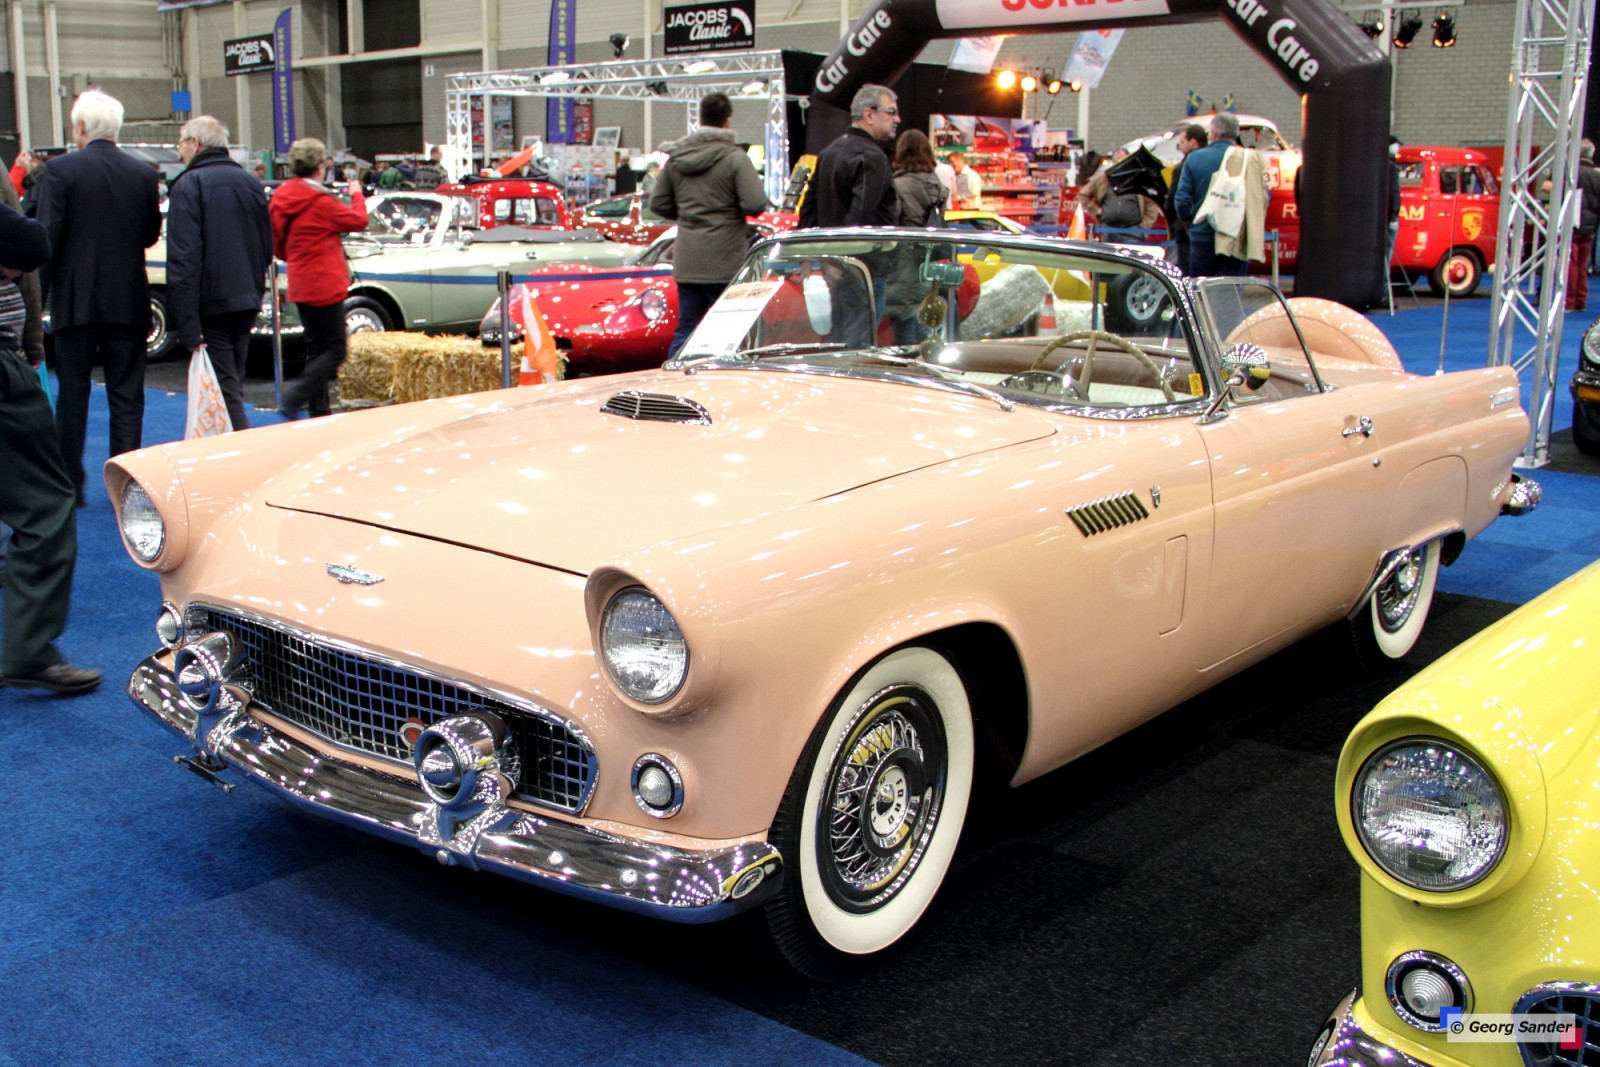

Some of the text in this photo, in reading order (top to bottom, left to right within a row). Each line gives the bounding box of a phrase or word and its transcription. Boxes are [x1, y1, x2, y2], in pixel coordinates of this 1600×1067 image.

[666, 8, 728, 28] JACOBS
[689, 22, 732, 41] Classic
[226, 41, 260, 56] JACOBS
[815, 9, 892, 93] Car Care
[1227, 0, 1319, 82] ar Care
[887, 778, 904, 825] FORD
